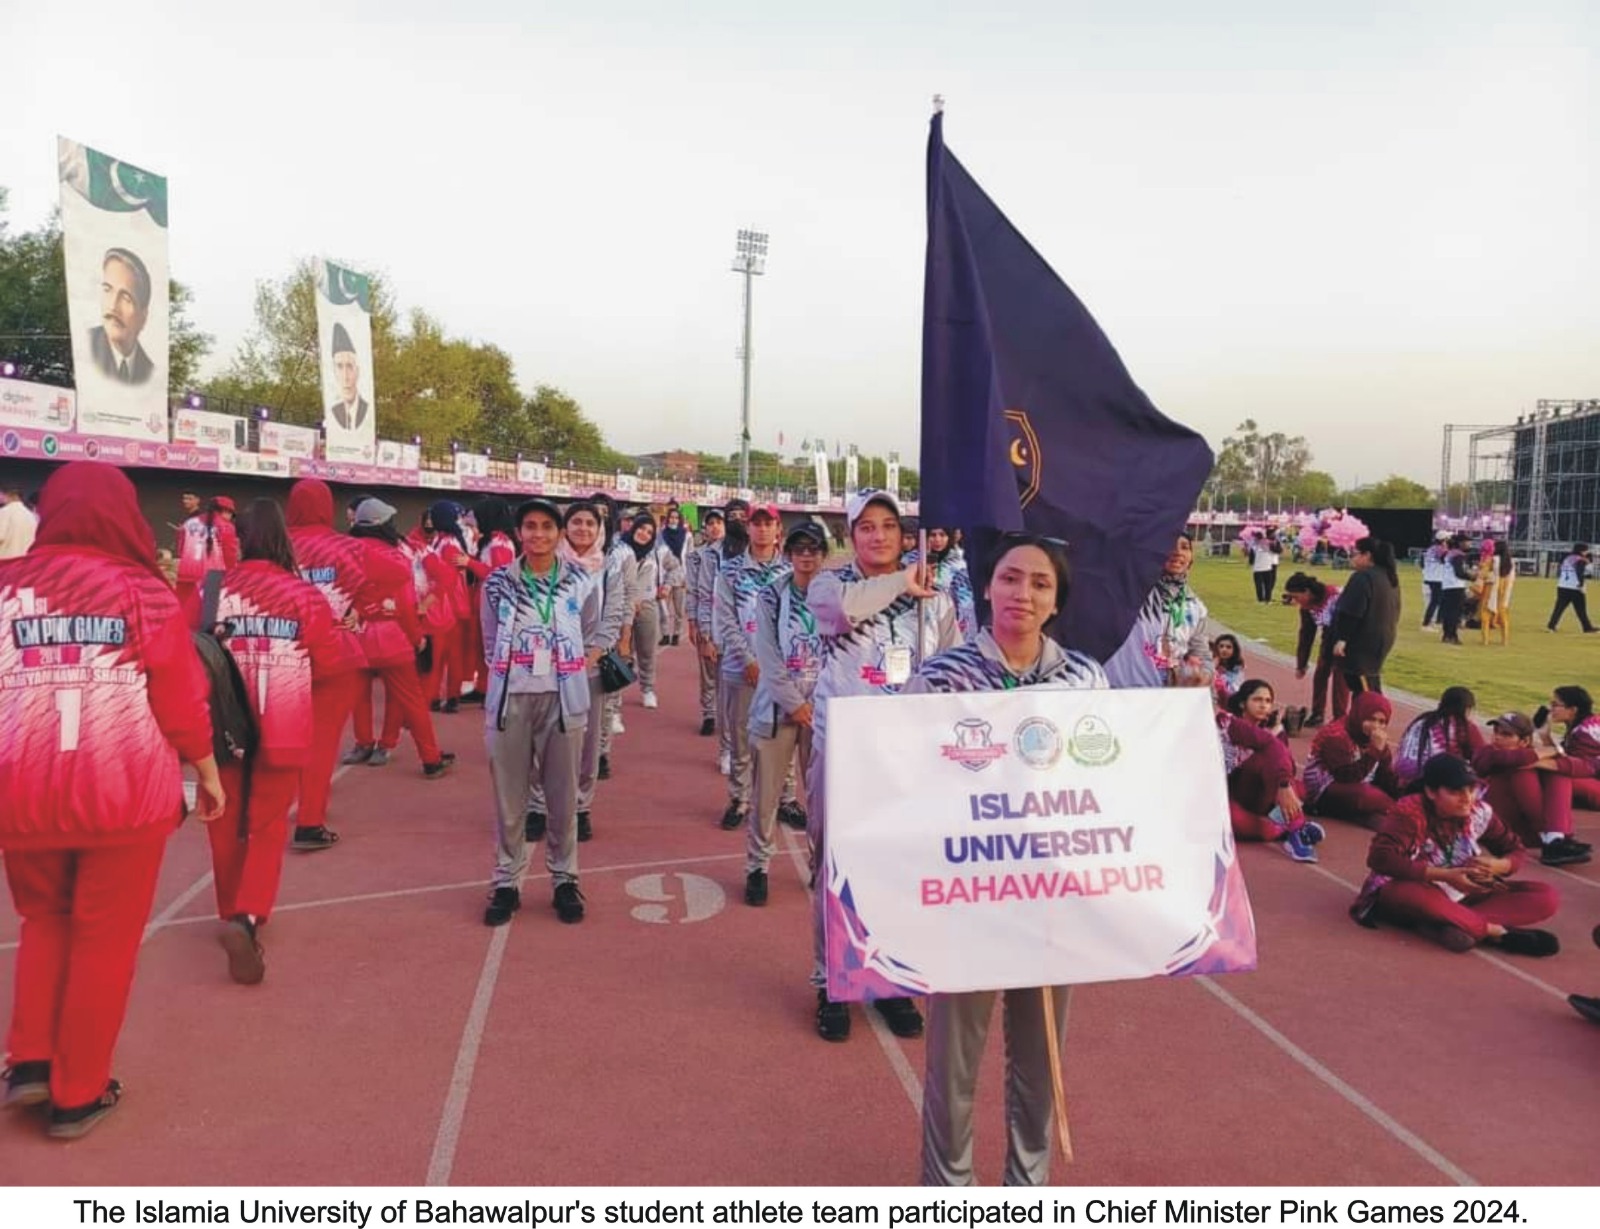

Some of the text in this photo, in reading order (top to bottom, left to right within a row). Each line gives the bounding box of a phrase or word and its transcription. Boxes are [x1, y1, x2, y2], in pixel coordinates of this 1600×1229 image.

[16, 616, 125, 647] CM PINK GAMES
[55, 689, 82, 751] 1
[970, 789, 1101, 821] ISLAMIA
[944, 826, 1134, 864] UNIVERSITY
[921, 865, 1165, 906] BAHAWALPUR
